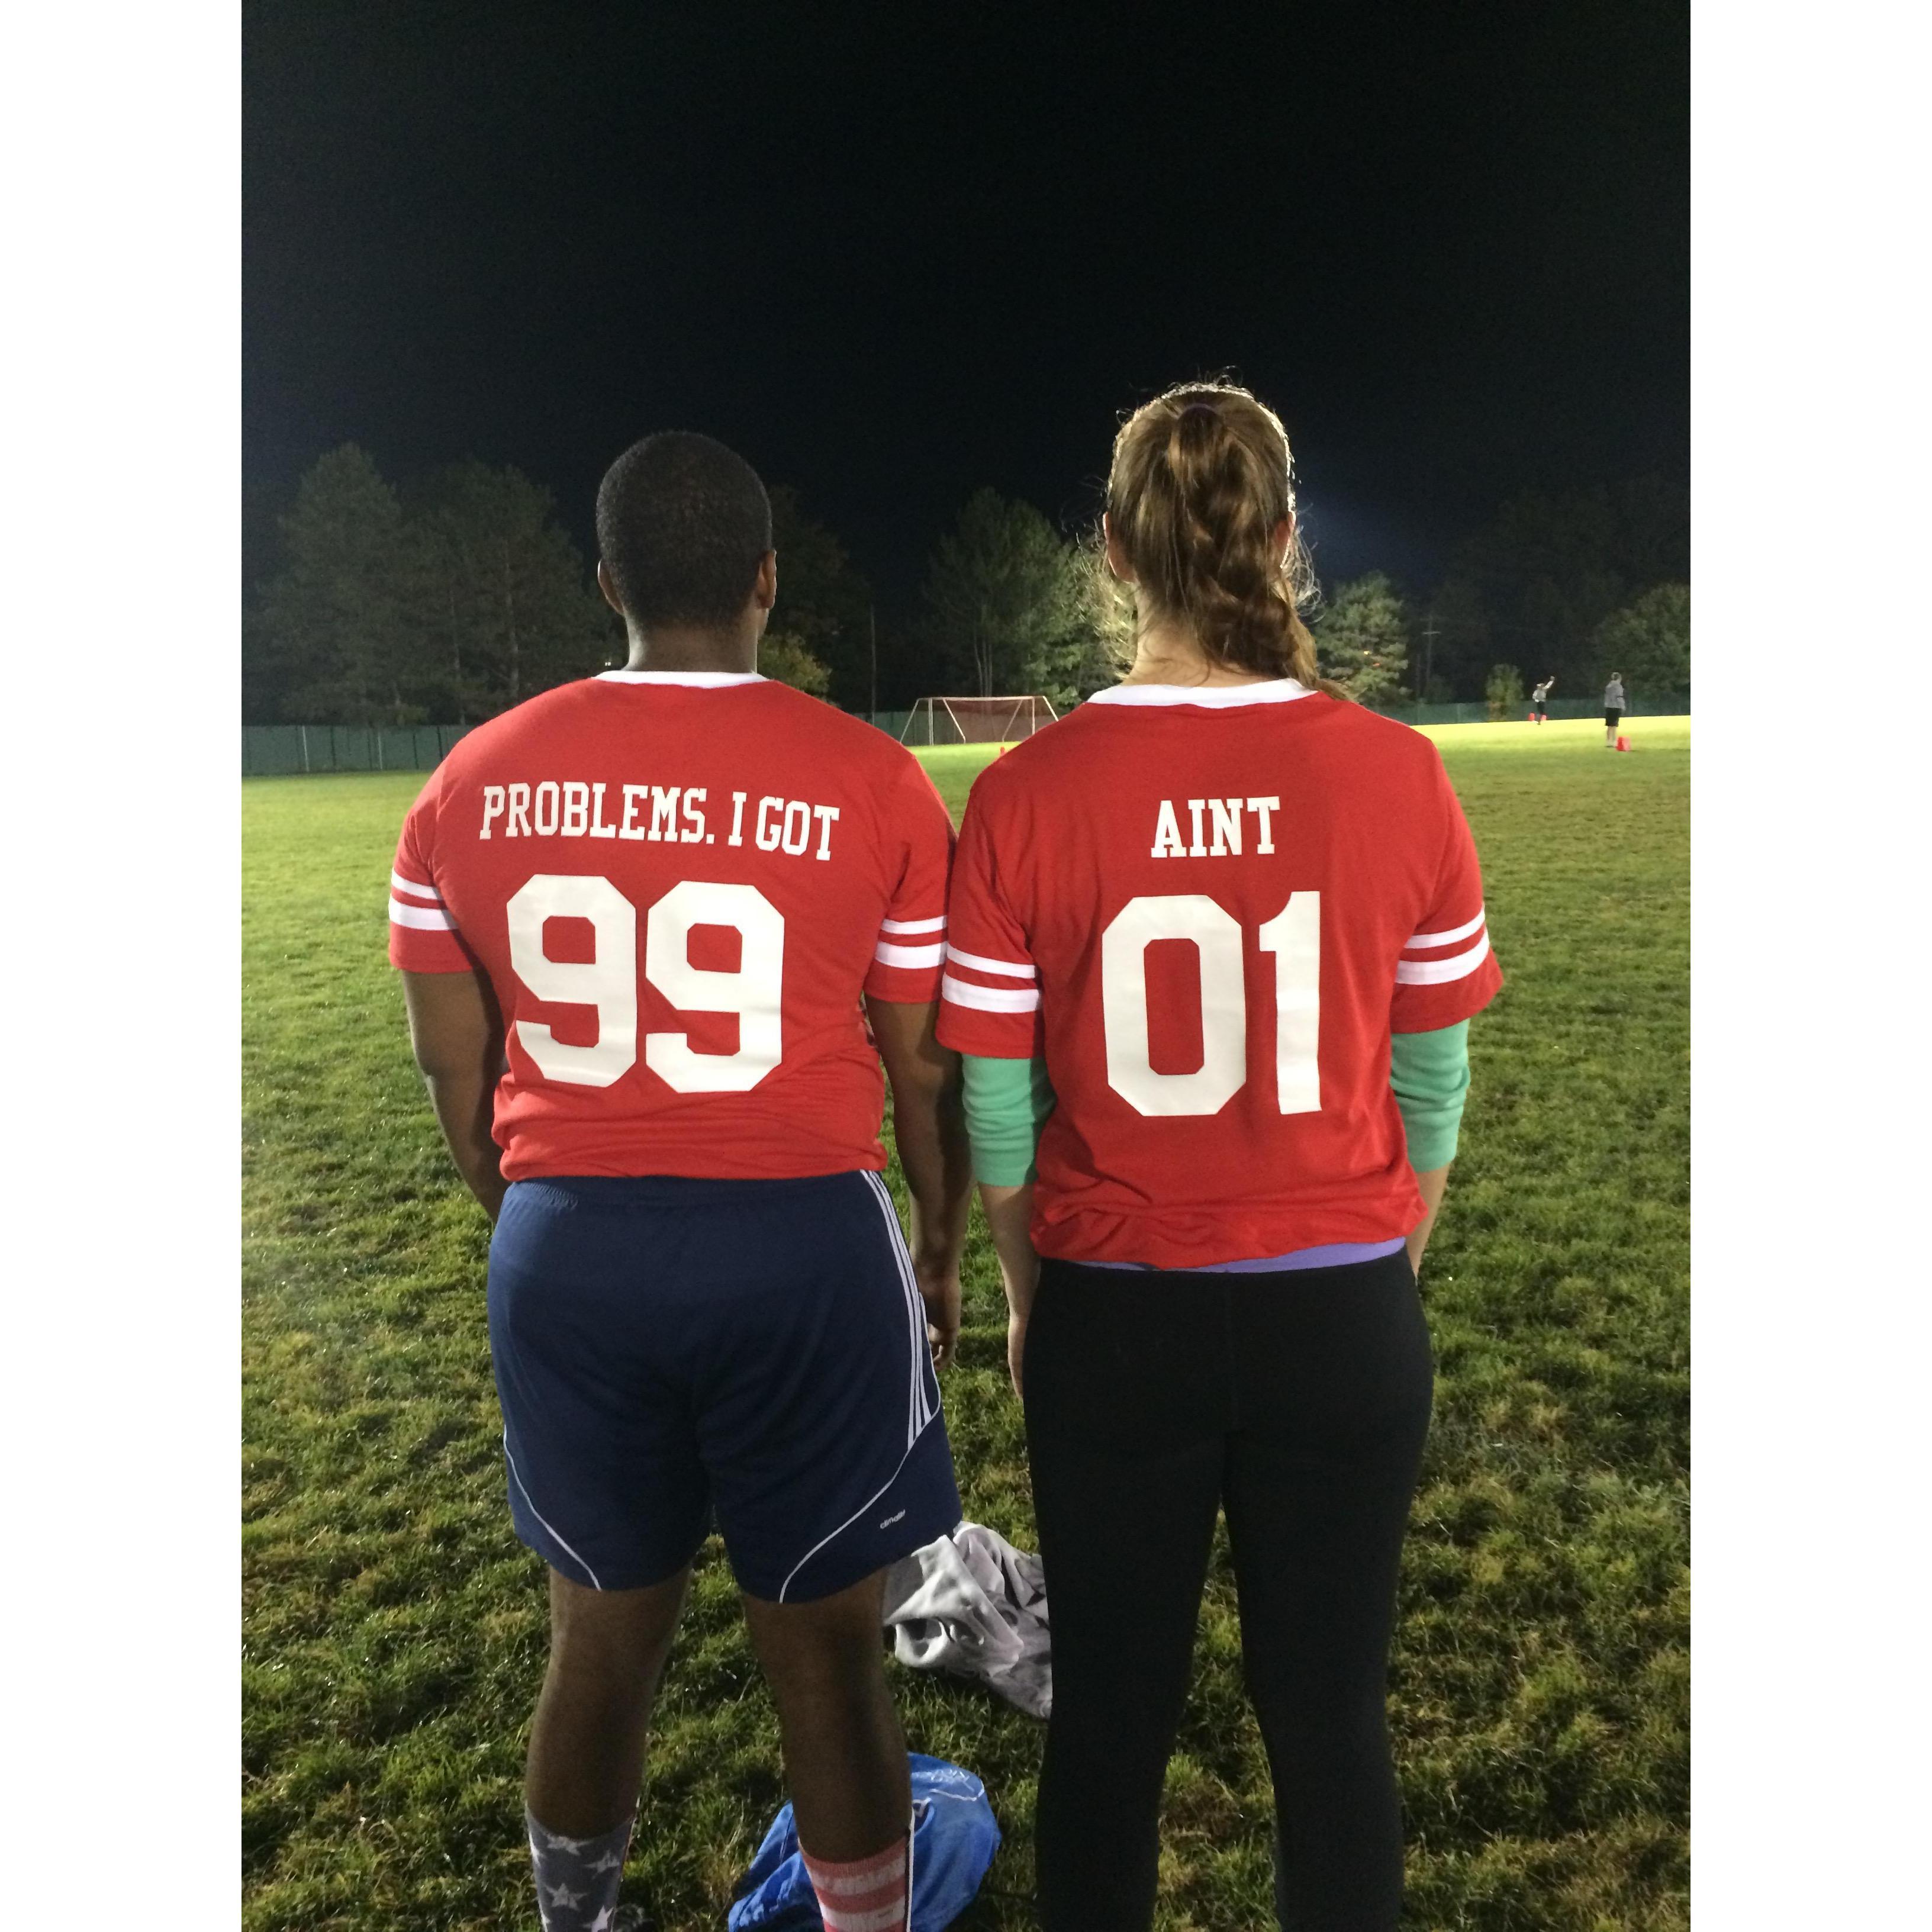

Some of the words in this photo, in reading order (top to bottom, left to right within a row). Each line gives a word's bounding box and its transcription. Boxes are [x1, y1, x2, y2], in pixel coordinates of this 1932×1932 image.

[479, 781, 714, 844] PROBLEMS.
[728, 791, 747, 846] I
[755, 796, 840, 861] GOT
[1151, 796, 1280, 858] AINT
[506, 874, 785, 1094] 99
[1102, 891, 1322, 1117] 01
